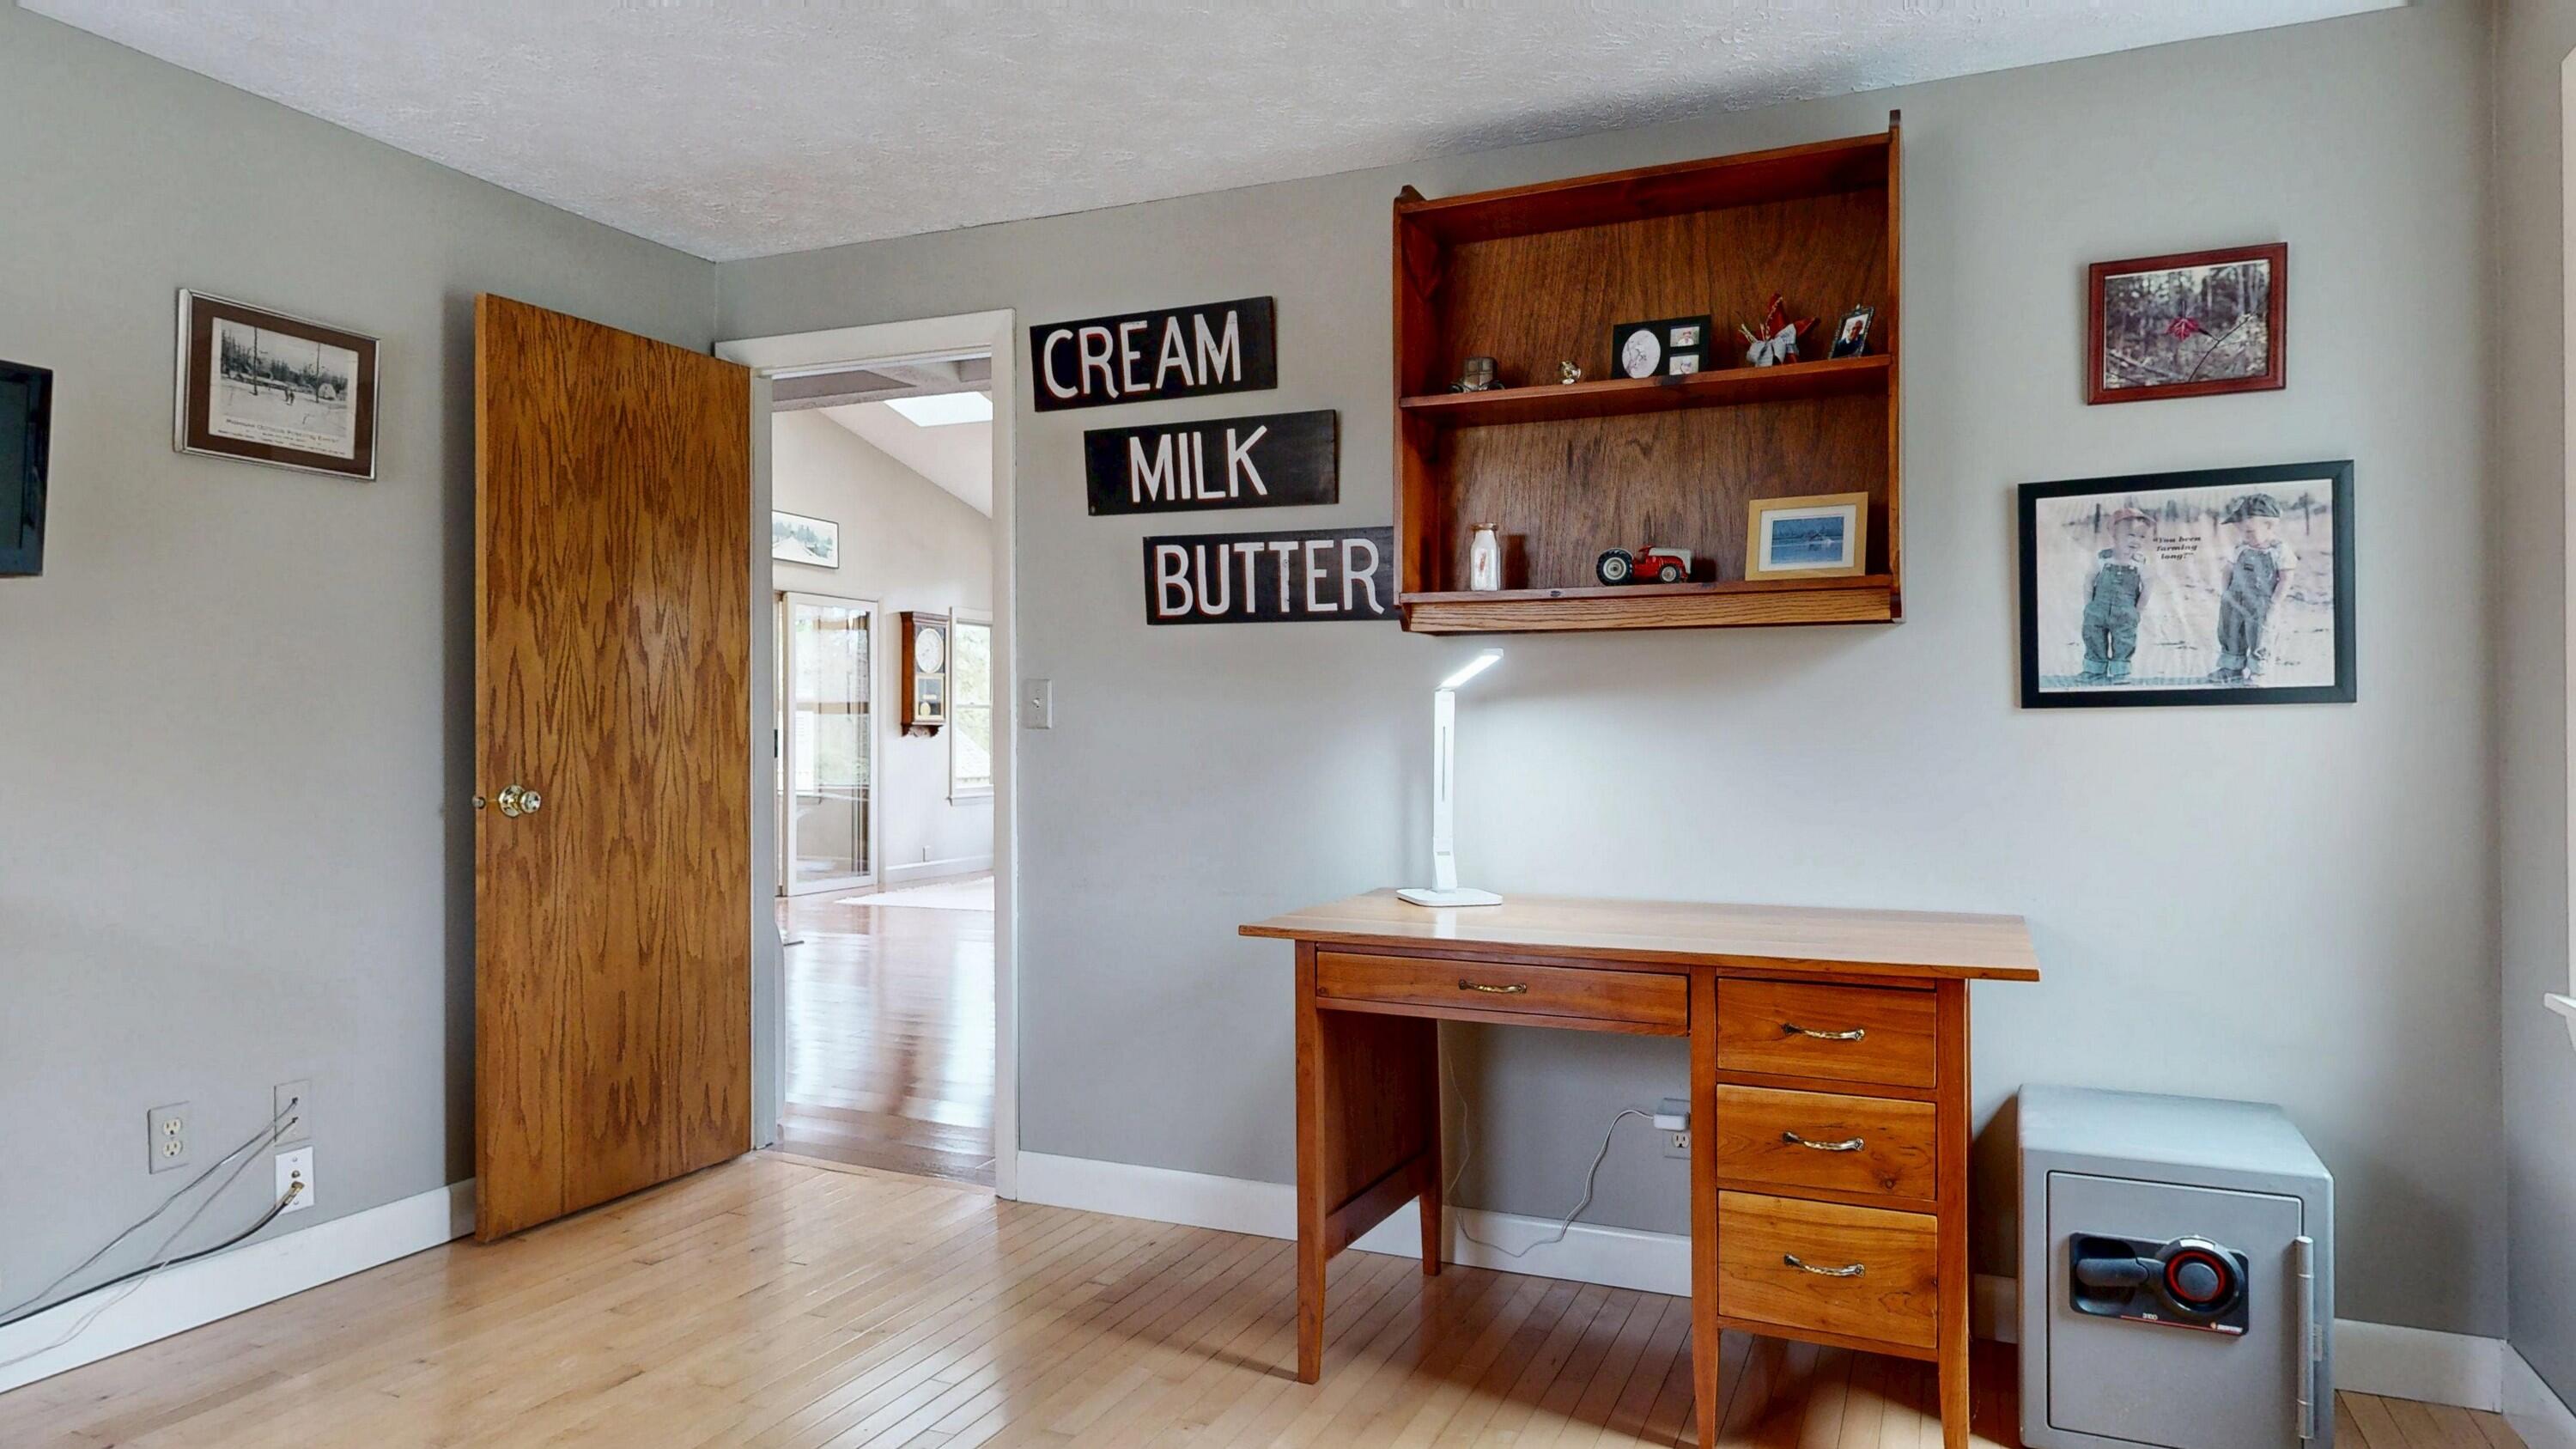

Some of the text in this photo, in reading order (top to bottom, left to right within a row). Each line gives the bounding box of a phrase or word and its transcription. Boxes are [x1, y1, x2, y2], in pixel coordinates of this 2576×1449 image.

[1043, 310, 1242, 399] CREAM
[1129, 425, 1268, 503] MILK
[1155, 539, 1384, 618] BUTTER
